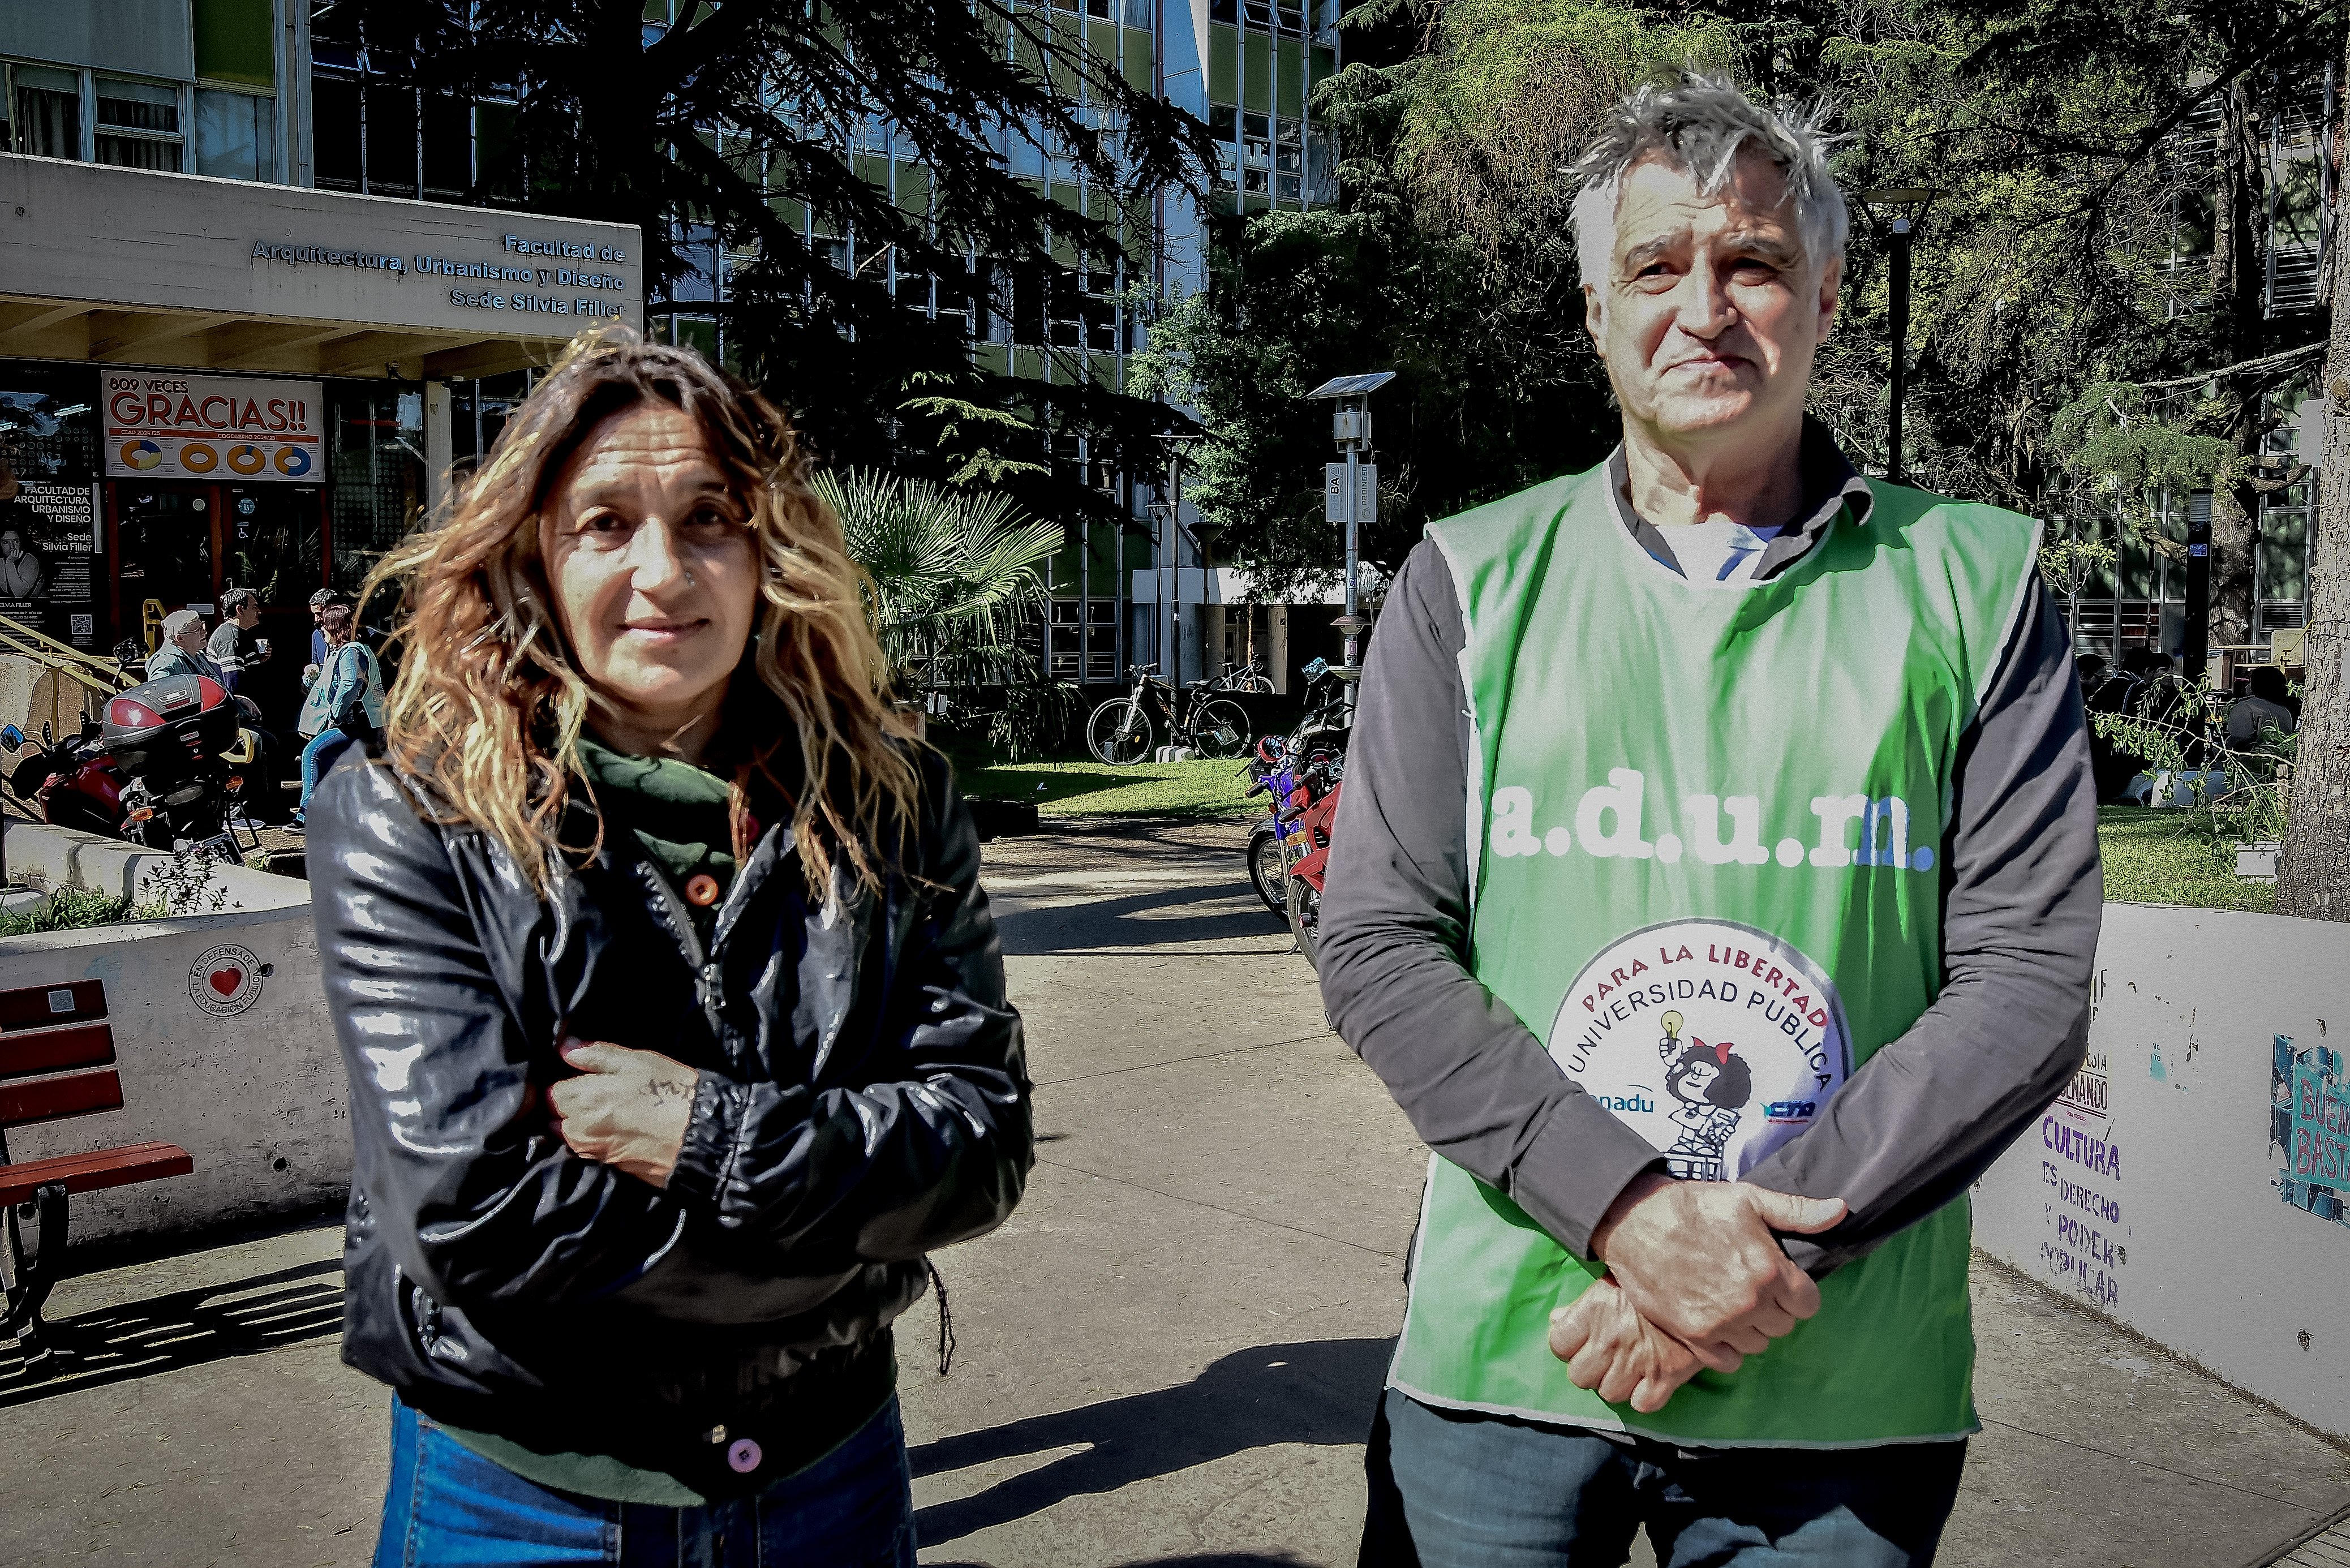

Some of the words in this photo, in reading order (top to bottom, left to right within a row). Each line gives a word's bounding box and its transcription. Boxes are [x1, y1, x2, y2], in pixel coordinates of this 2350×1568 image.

[504, 234, 595, 260] Facultad
[599, 244, 626, 263] de
[252, 240, 410, 273] Arquitectura,
[414, 255, 533, 283] Urbanismo
[538, 269, 554, 287] y
[556, 268, 624, 290] Diseño
[450, 289, 506, 310] Sede
[510, 293, 569, 315] Silvia
[109, 377, 140, 391] 809
[143, 379, 189, 394] VECES
[109, 391, 307, 432] GRACIAS!!
[14, 496, 91, 505] ARQUITECTURA,
[25, 486, 75, 495] FACULTAD
[32, 505, 91, 513] URBANISMO
[55, 514, 91, 523] DISEÑO
[42, 542, 68, 551] Silvia
[70, 542, 92, 551] Filler
[1490, 767, 1935, 872] a.d.u.m.
[194, 964, 204, 978] EN
[192, 981, 200, 994] LA
[1582, 959, 1649, 1012] PARA
[1660, 945, 1694, 964] LA
[1709, 944, 1828, 1027] LIBERTAD
[1568, 980, 1738, 1073] UNIVERSIDAD
[1747, 990, 1832, 1092] PUBLICA
[1589, 1094, 1654, 1113] nadu
[2300, 1077, 2350, 1138] BUEN
[2043, 1115, 2120, 1182] CULTURA
[2296, 1127, 2350, 1183] BAST
[2043, 1161, 2058, 1187] ES
[2060, 1178, 2120, 1223] DERECHO
